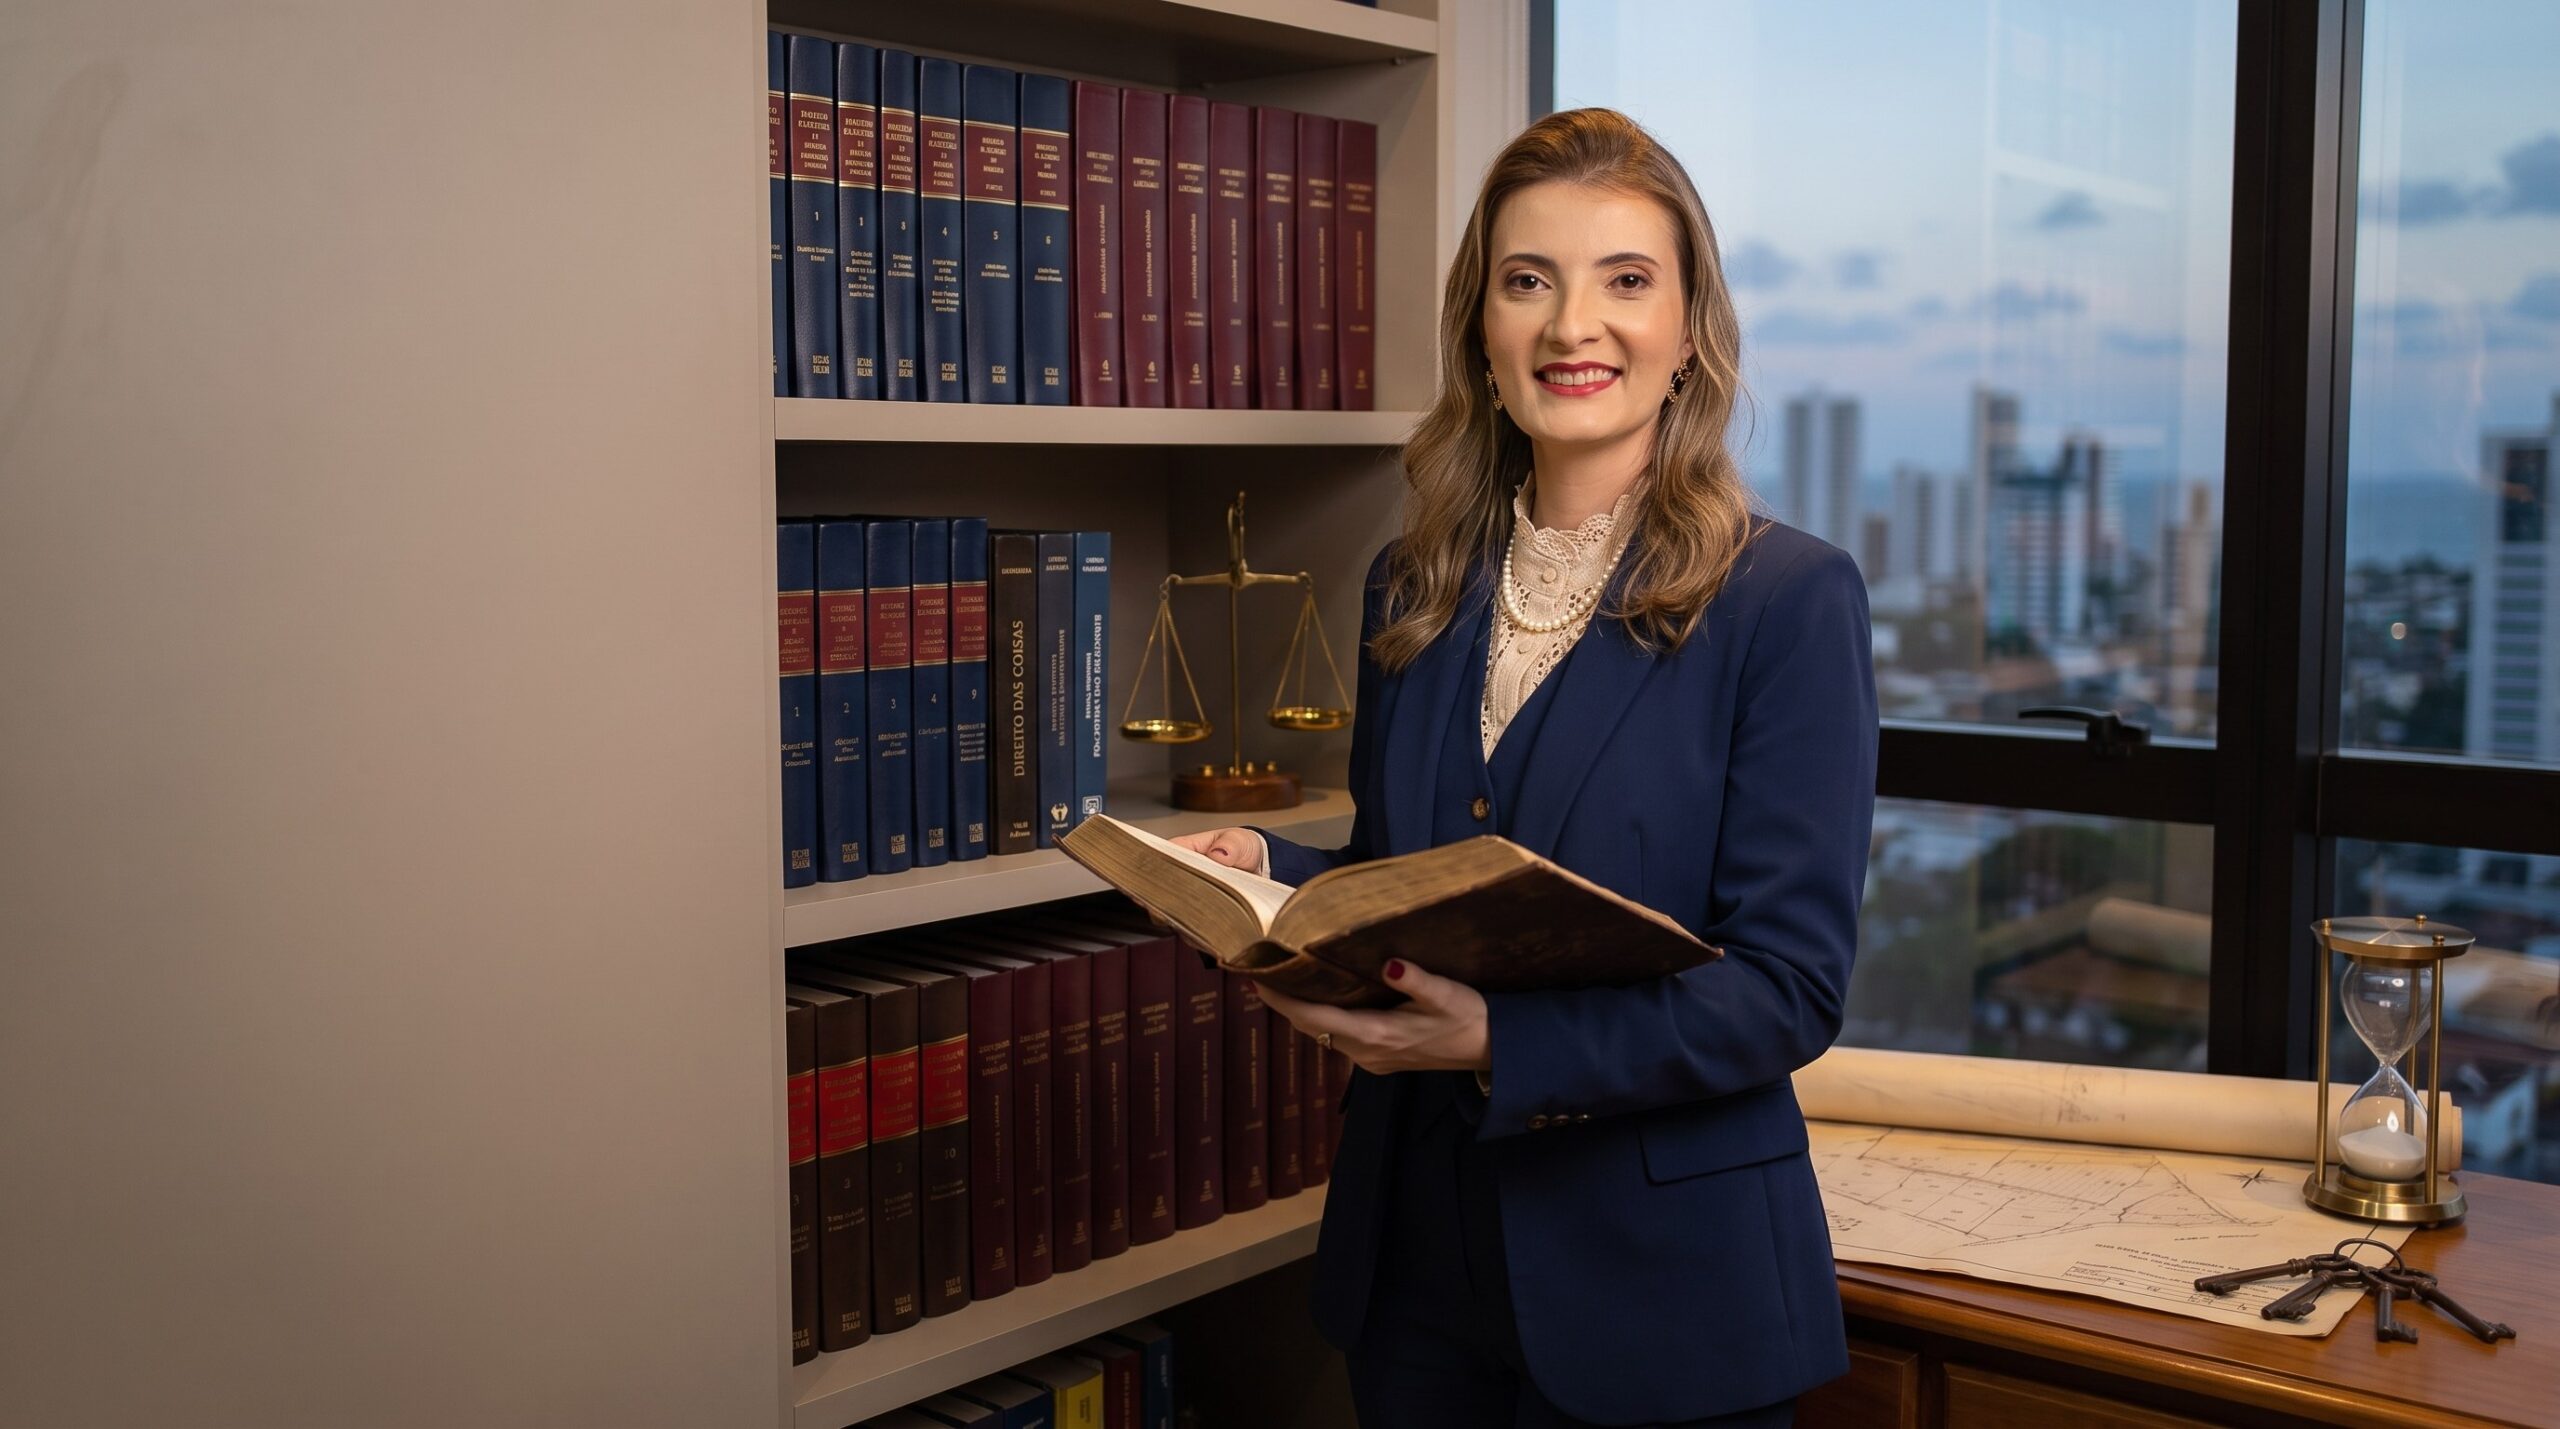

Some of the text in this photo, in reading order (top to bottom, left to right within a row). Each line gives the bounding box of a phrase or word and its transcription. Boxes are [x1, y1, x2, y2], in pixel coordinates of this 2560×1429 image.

[814, 211, 819, 222] 1
[942, 226, 948, 237] 4
[992, 231, 999, 241] 5
[930, 693, 937, 704] 4
[971, 688, 977, 700] 9
[1013, 620, 1025, 777] DIREITO DAS COISAS
[843, 702, 850, 713] 2
[890, 698, 897, 709] 3
[794, 706, 800, 717] 1
